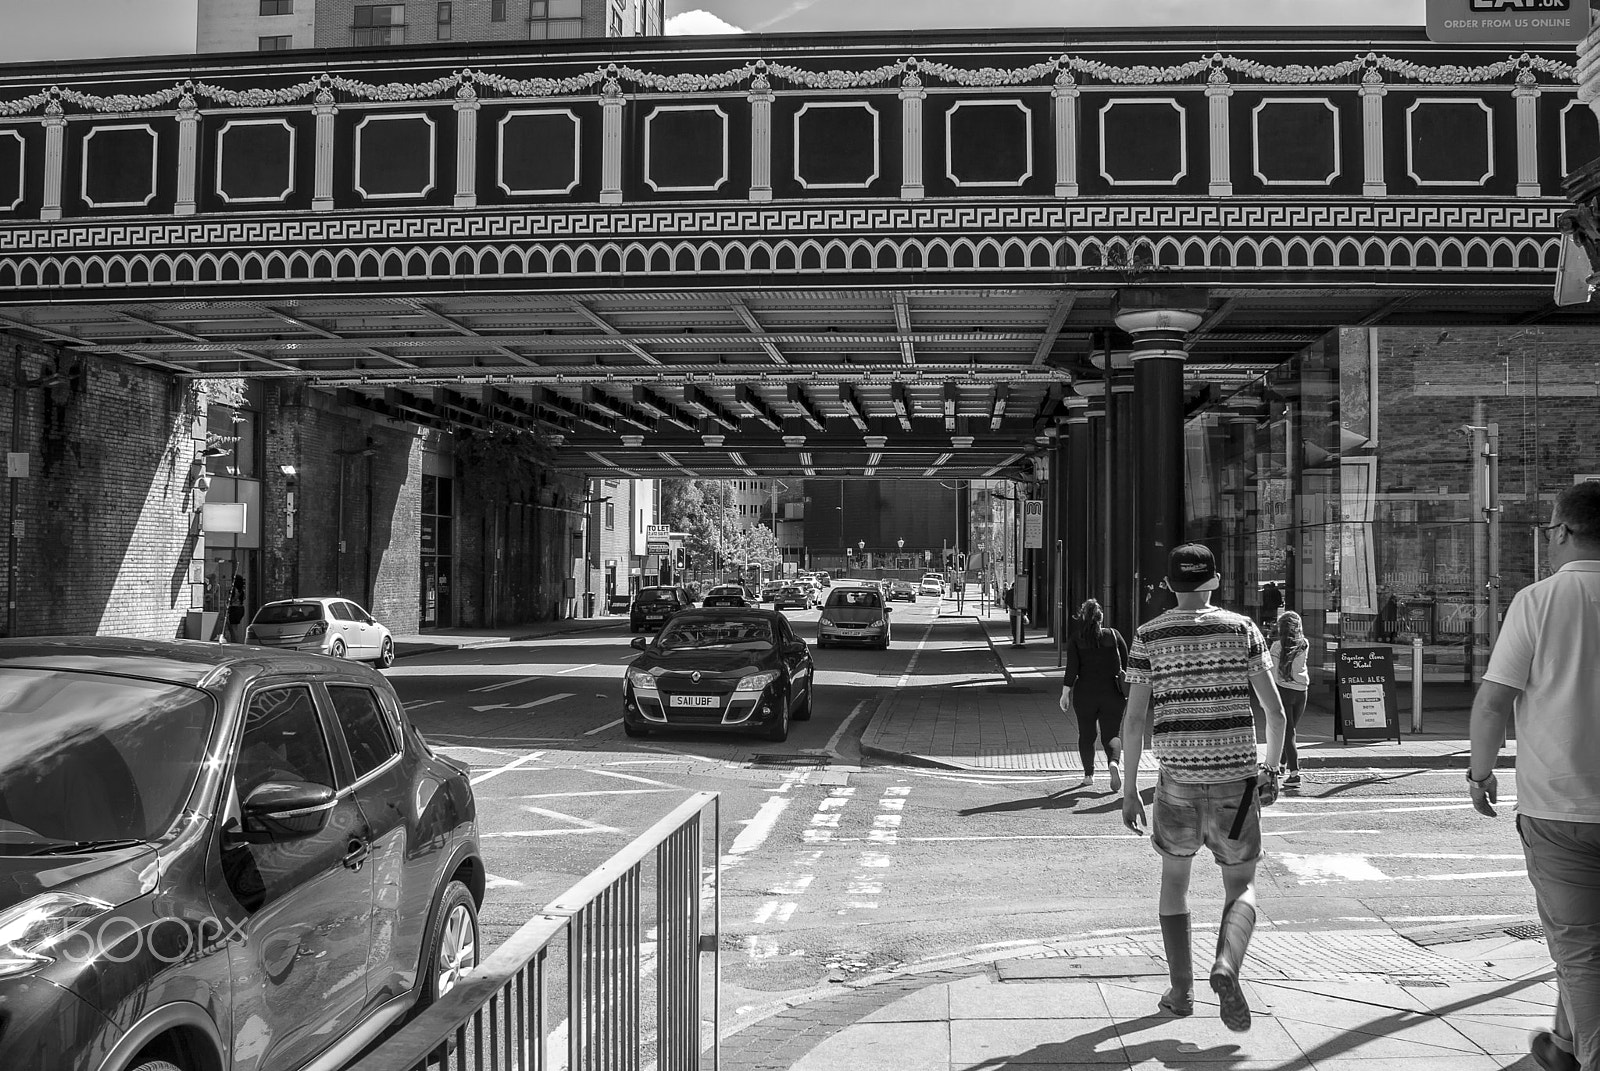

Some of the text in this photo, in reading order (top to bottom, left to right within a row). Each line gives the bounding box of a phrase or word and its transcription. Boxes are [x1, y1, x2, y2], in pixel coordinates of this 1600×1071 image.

[1444, 18, 1571, 29] ORDER FROM US ONLINE
[1341, 651, 1385, 664] Egerton Arms
[1353, 660, 1372, 668] Hotel
[1348, 676, 1365, 684] REAL
[1367, 675, 1386, 683] ALES
[677, 696, 713, 706] SA11 UBF
